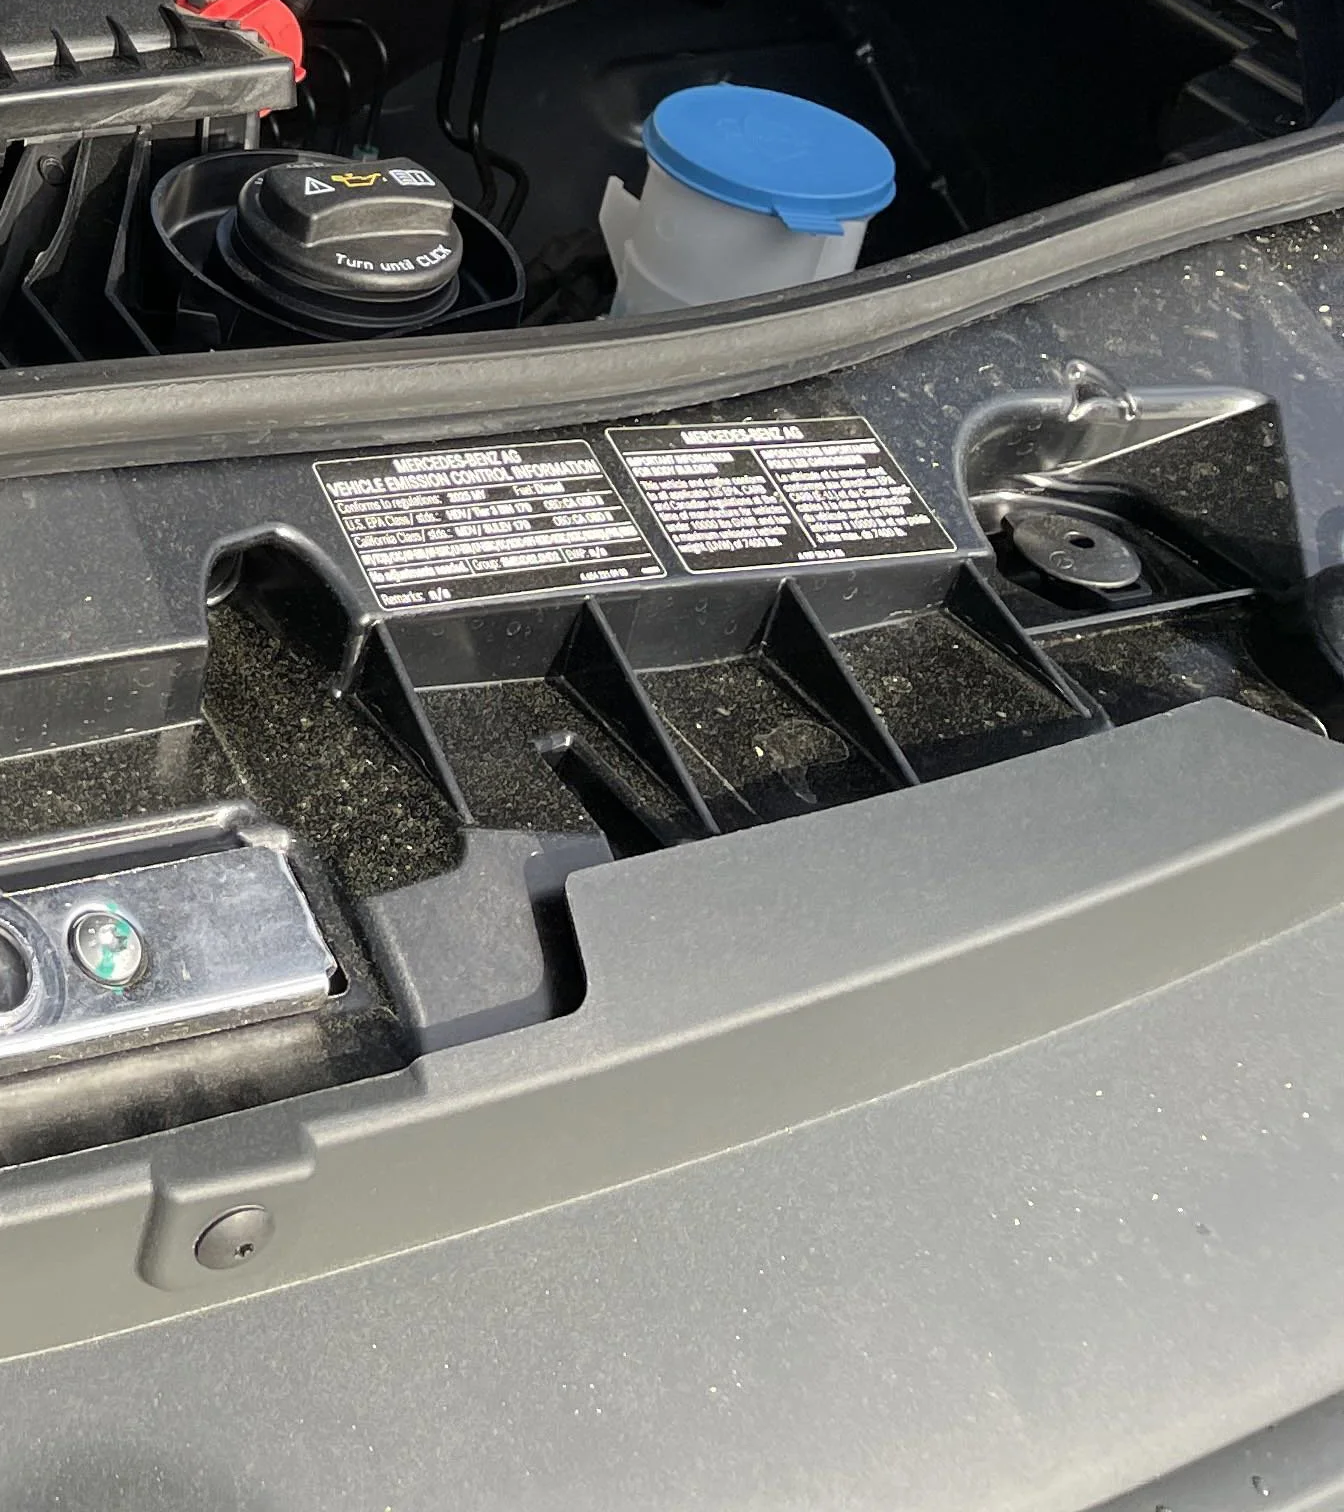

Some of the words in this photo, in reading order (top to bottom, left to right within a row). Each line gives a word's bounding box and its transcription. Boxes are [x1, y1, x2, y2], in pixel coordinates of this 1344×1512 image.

[335, 252, 374, 271] Turn
[380, 258, 415, 273] until
[416, 243, 453, 268] CLICK
[681, 427, 782, 444] MERCEDES-BENZ
[782, 425, 804, 439] AG
[394, 451, 499, 472] MERCEDES-BENZ
[500, 449, 521, 464] AG
[326, 477, 385, 496] VEHICLE
[384, 472, 450, 491] EMISSION
[450, 467, 512, 484] CONTROL
[511, 459, 598, 478] INFORMATION
[337, 501, 381, 513] Conforms
[379, 498, 392, 509] to
[391, 494, 441, 509] regulations:
[344, 518, 366, 531] U.S.
[364, 516, 386, 528] EPA
[353, 534, 397, 548] California
[741, 537, 766, 547] 7400
[471, 559, 501, 570] Group:
[380, 591, 425, 605] Remarks:
[427, 587, 451, 601] n/a
